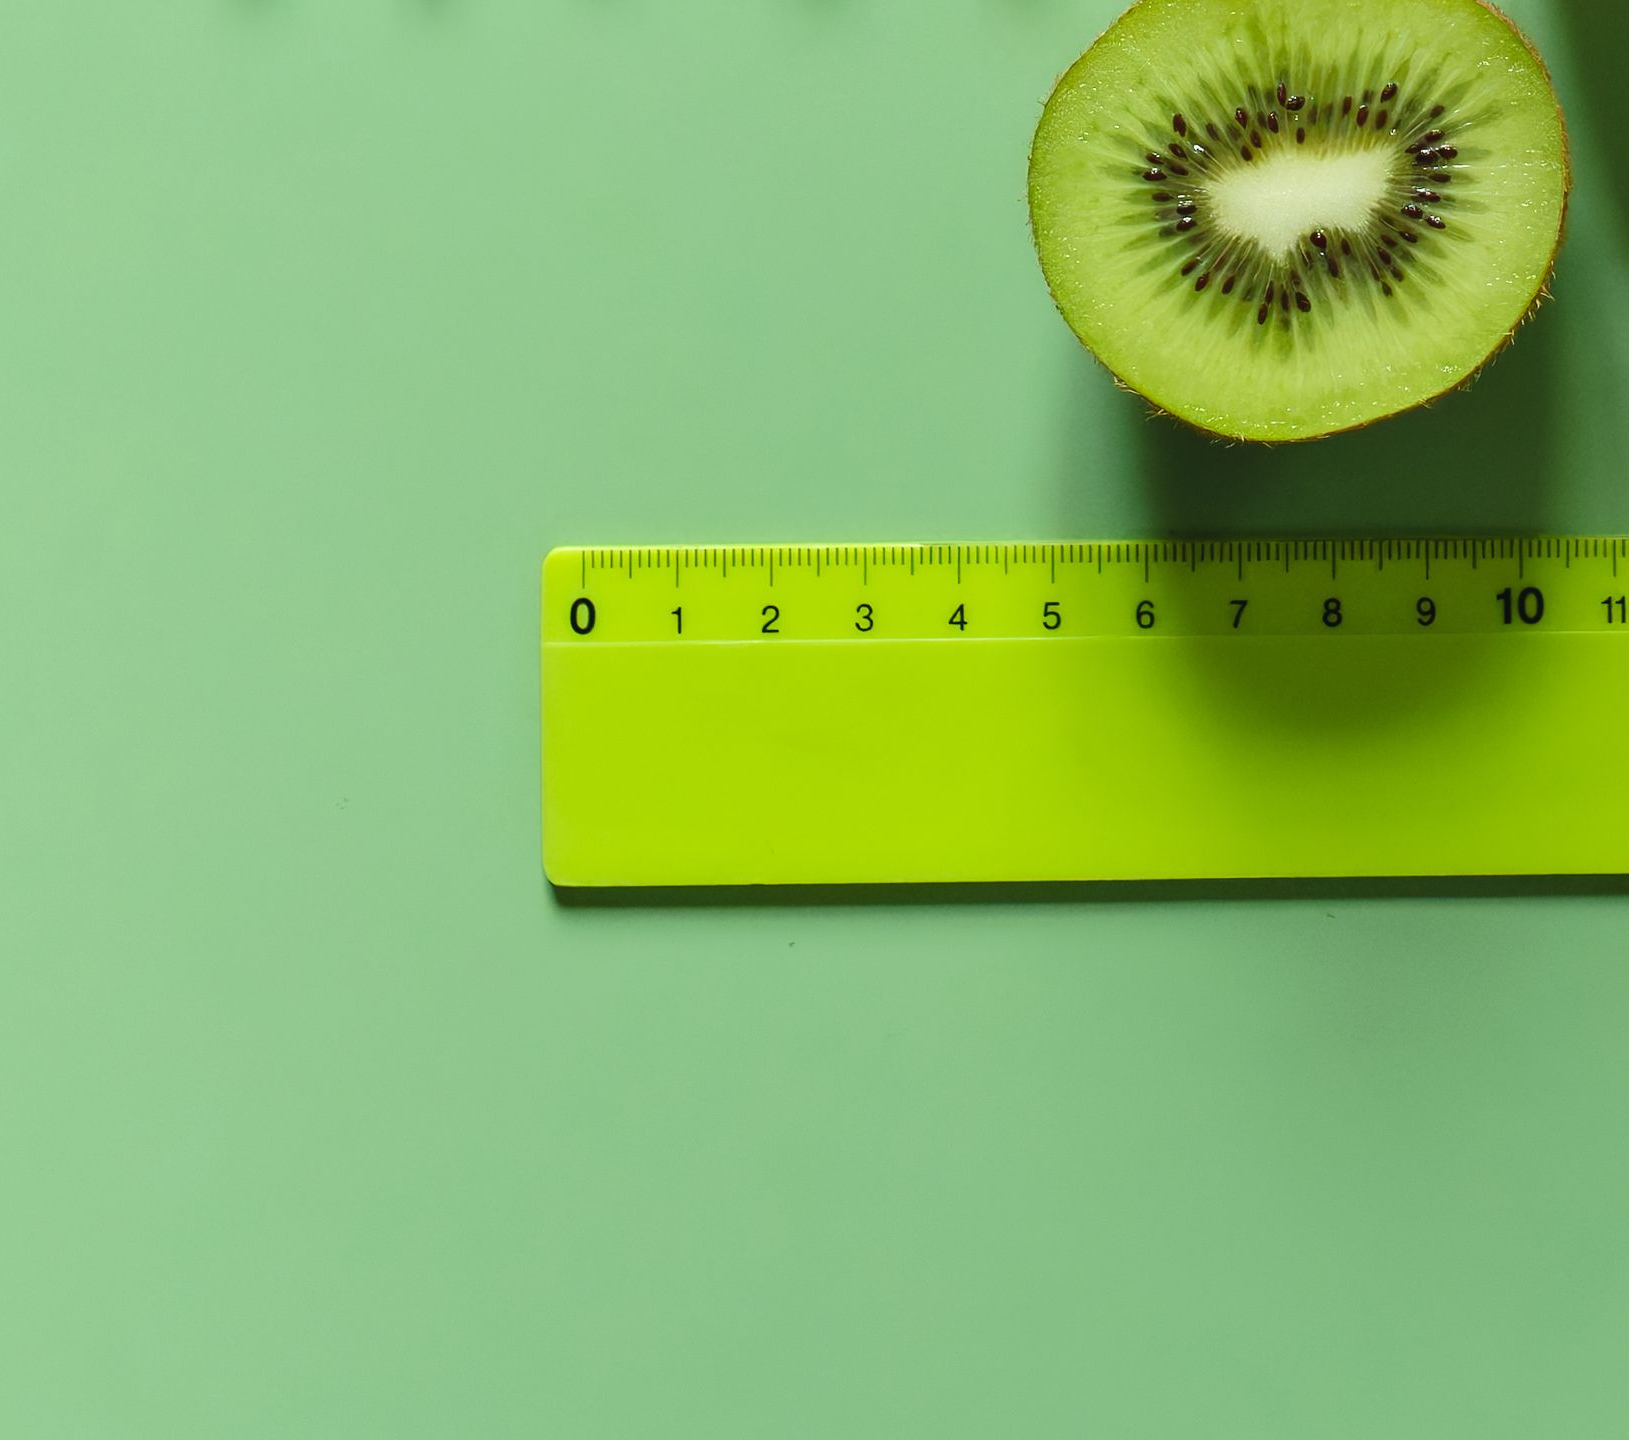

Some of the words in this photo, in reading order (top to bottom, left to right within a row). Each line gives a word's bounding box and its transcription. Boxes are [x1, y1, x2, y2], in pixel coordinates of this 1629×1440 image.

[569, 597, 596, 635] 0
[671, 606, 682, 634] 1
[761, 605, 780, 634] 2
[855, 603, 874, 633] 3
[948, 603, 968, 632] 4
[1042, 601, 1062, 630] 5
[1135, 599, 1156, 629] 6
[1229, 599, 1248, 629] 7
[1321, 597, 1343, 628] 8
[1416, 596, 1436, 627] 9
[1495, 586, 1545, 625] 10
[1601, 595, 1626, 624] 11
